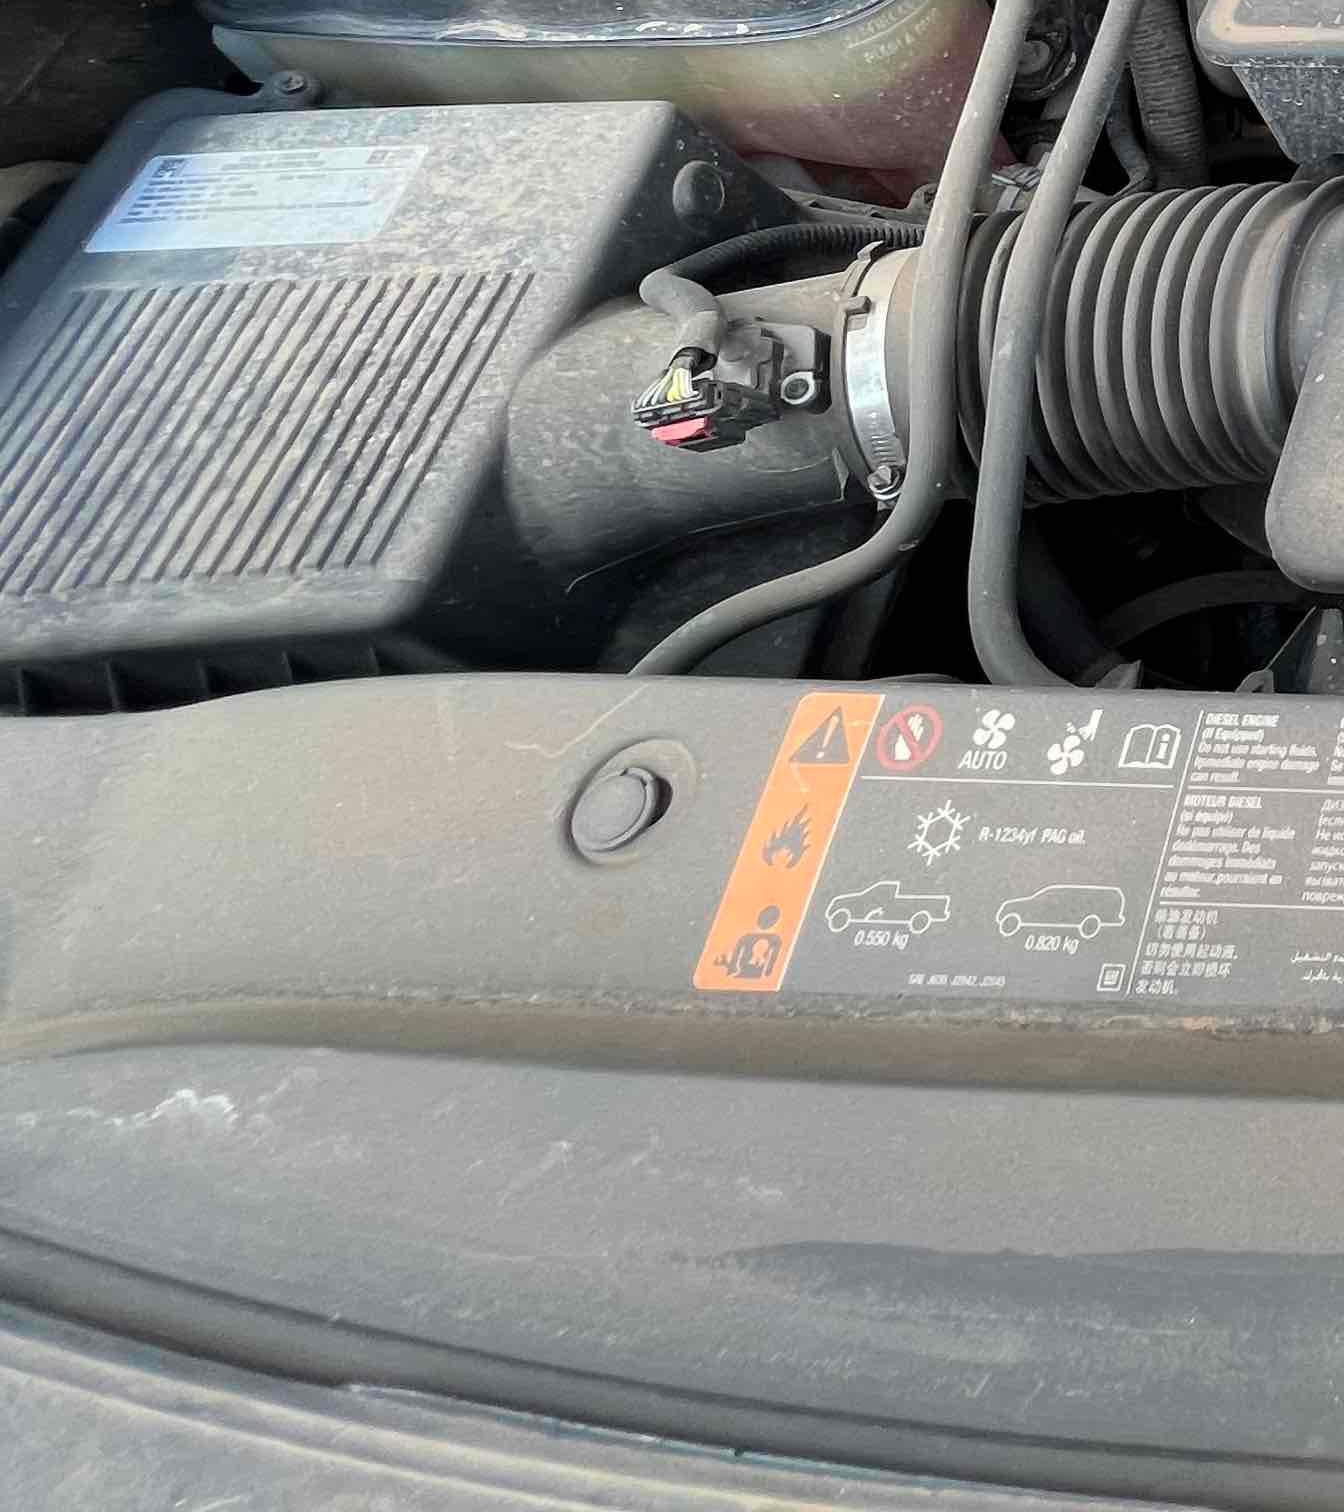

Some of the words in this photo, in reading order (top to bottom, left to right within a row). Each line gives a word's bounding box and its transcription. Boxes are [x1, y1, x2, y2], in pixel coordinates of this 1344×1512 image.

[1206, 713, 1240, 726] DIESEL
[958, 749, 1007, 770] AUTO
[1184, 794, 1227, 807] MOTEUR
[1228, 796, 1263, 808] DIESEL
[978, 826, 1038, 846] R-1234yf
[1041, 828, 1068, 843] PAG
[854, 929, 891, 947] 0.550
[892, 931, 910, 950] kg
[1024, 935, 1061, 951] 0.820
[1062, 937, 1080, 954] kg
